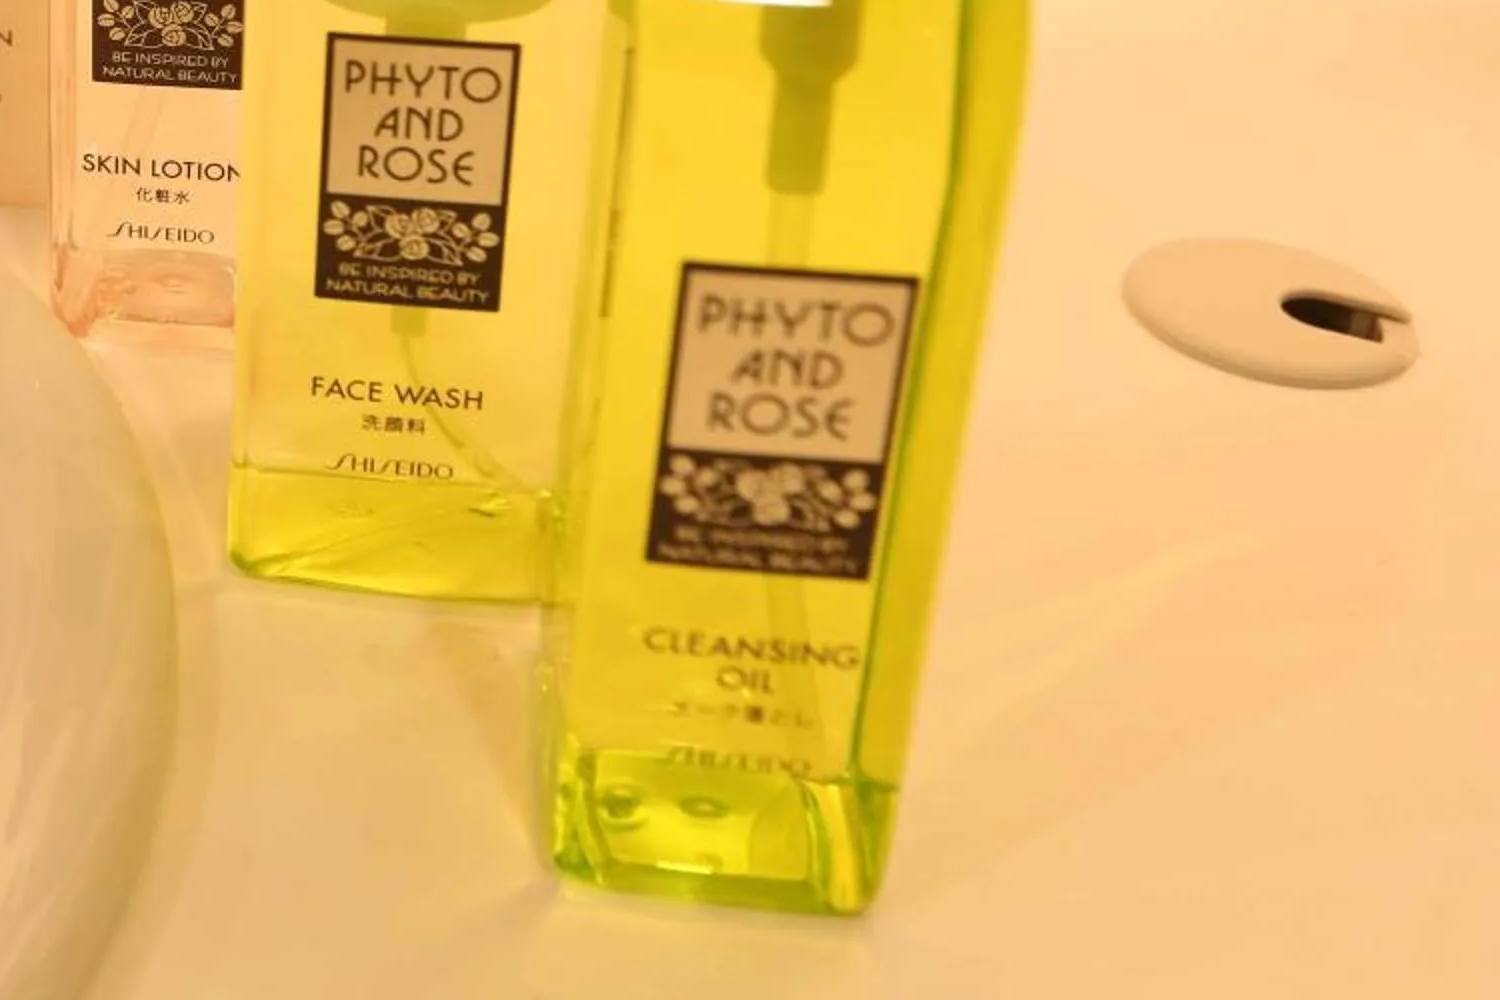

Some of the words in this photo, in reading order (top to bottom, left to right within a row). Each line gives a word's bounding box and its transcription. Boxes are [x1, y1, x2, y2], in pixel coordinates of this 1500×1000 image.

[112, 51, 132, 63] BE
[135, 51, 208, 67] INSPIRED
[211, 56, 229, 69] BY
[102, 66, 176, 81] NATURAL
[177, 69, 237, 83] BEAUTY
[345, 59, 501, 103] PHYTO
[374, 106, 464, 142] AND
[82, 153, 141, 176] SKIN
[357, 145, 476, 186] ROSE
[136, 187, 190, 204] 化粧水
[106, 221, 216, 244] SHISEIDO
[366, 264, 454, 285] INSPIRED
[326, 278, 413, 299] NATURAL
[416, 285, 490, 304] BEAUTY
[698, 293, 896, 348] PHYTO
[731, 349, 844, 390] AND
[311, 376, 384, 402] FACE
[394, 384, 484, 411] WASH
[362, 414, 426, 435] 洗顔料
[707, 392, 855, 441] ROSE
[325, 453, 455, 480] SHISEIDO
[642, 627, 861, 671] CLEANSING
[715, 666, 774, 695] OIL
